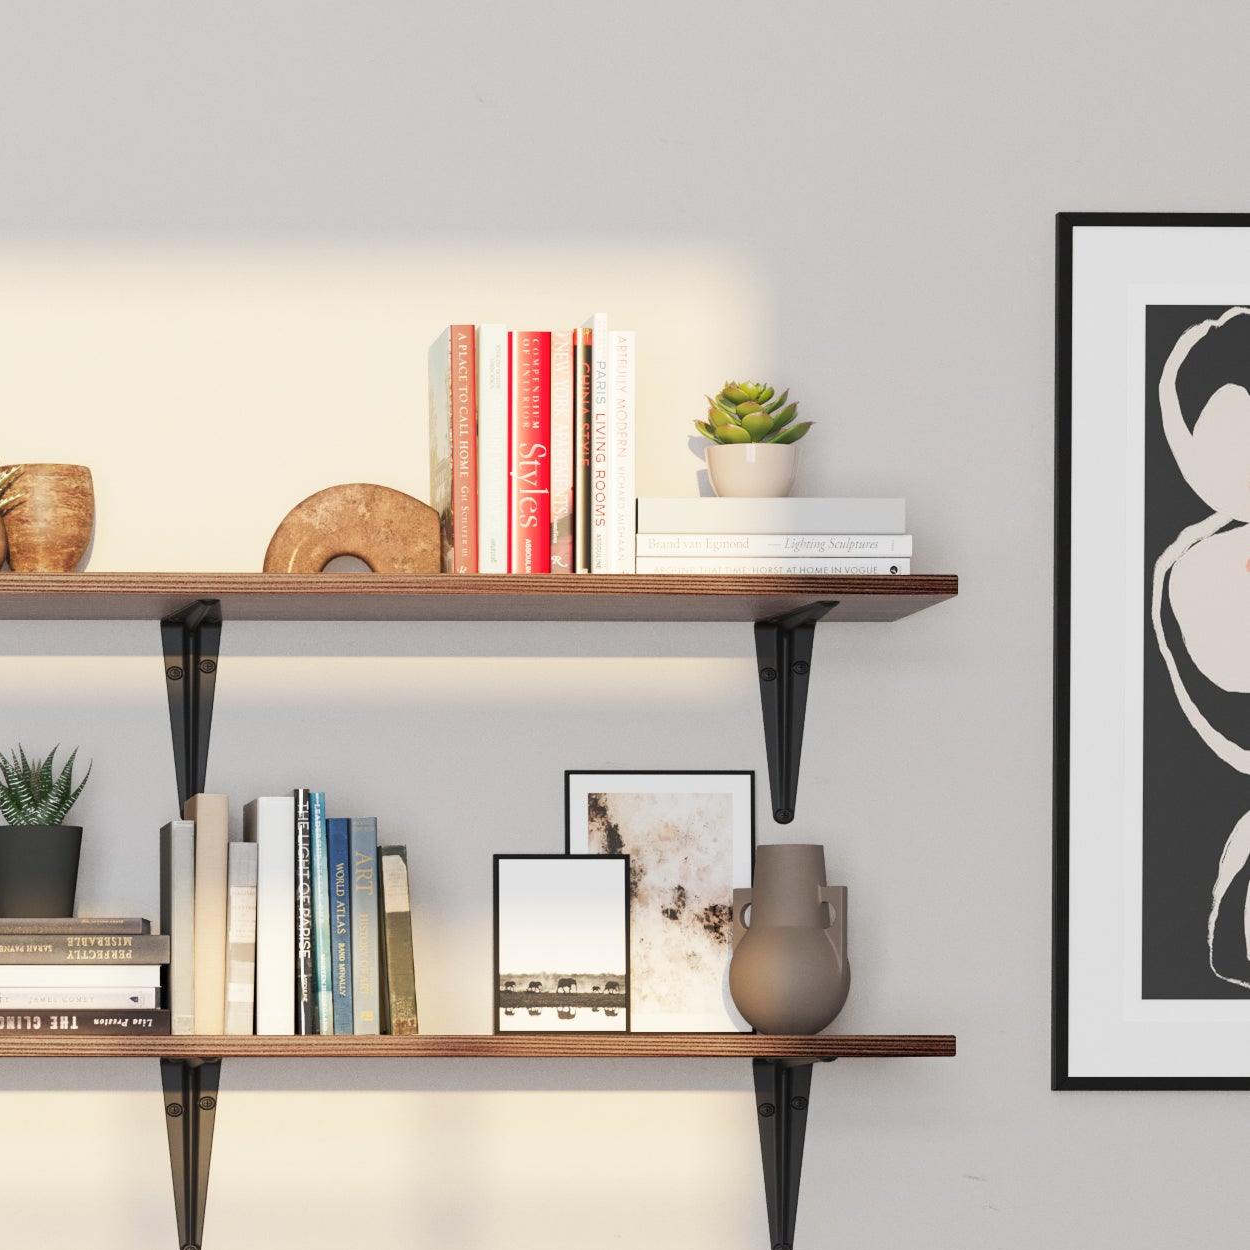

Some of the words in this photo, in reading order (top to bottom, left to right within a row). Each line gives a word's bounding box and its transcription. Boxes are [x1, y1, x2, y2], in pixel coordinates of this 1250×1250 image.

[457, 332, 468, 341] A
[522, 338, 530, 355] OF
[458, 344, 468, 382] PLACE
[553, 342, 569, 375] NEW
[616, 335, 628, 393] ARTFULLY
[458, 385, 469, 403] TO
[522, 362, 530, 428] INTERIOR
[531, 338, 540, 429] COMPENDIUM
[553, 378, 569, 417] YORK
[581, 362, 591, 415] CHINA
[595, 361, 607, 405] PARIS
[459, 406, 469, 437] CALL
[595, 413, 607, 463] LIVING
[616, 398, 628, 458] MODERN
[459, 440, 469, 478] HOME
[581, 422, 591, 467] STYLE
[553, 420, 569, 514] APARTMENTS
[510, 443, 549, 528] Styles
[595, 470, 606, 527] ROOMS
[617, 513, 626, 561] MISHAAN
[647, 538, 680, 550] Brand
[682, 541, 702, 550] van
[705, 538, 750, 553] Egmond
[783, 537, 826, 553] Lighting
[827, 537, 879, 553] Sculptures
[524, 539, 532, 574] ASSOULIN
[752, 566, 783, 574] HORST
[785, 566, 798, 574] AT
[799, 566, 828, 574] HOME
[830, 566, 842, 574] IN
[844, 566, 878, 574] VOGUE
[298, 801, 310, 830] THE
[298, 835, 310, 879] LIGHT
[355, 851, 374, 896] ART
[298, 883, 310, 905] OF
[335, 862, 345, 897] WORLD
[336, 901, 346, 935] ATLAS
[0, 944, 25, 953] PAYNE
[26, 944, 53, 953] SARAH
[67, 936, 133, 947] MISERABLE
[337, 942, 346, 962] RAND
[358, 913, 369, 958] HISTORY
[67, 949, 133, 960] PERFECTLY
[358, 959, 369, 972] OF
[29, 996, 58, 1004] JAMES
[61, 996, 95, 1004] COMEY
[358, 975, 369, 996] ART
[48, 1015, 79, 1030] THE
[93, 1017, 128, 1027] Preston
[131, 1017, 153, 1027] Lisa
